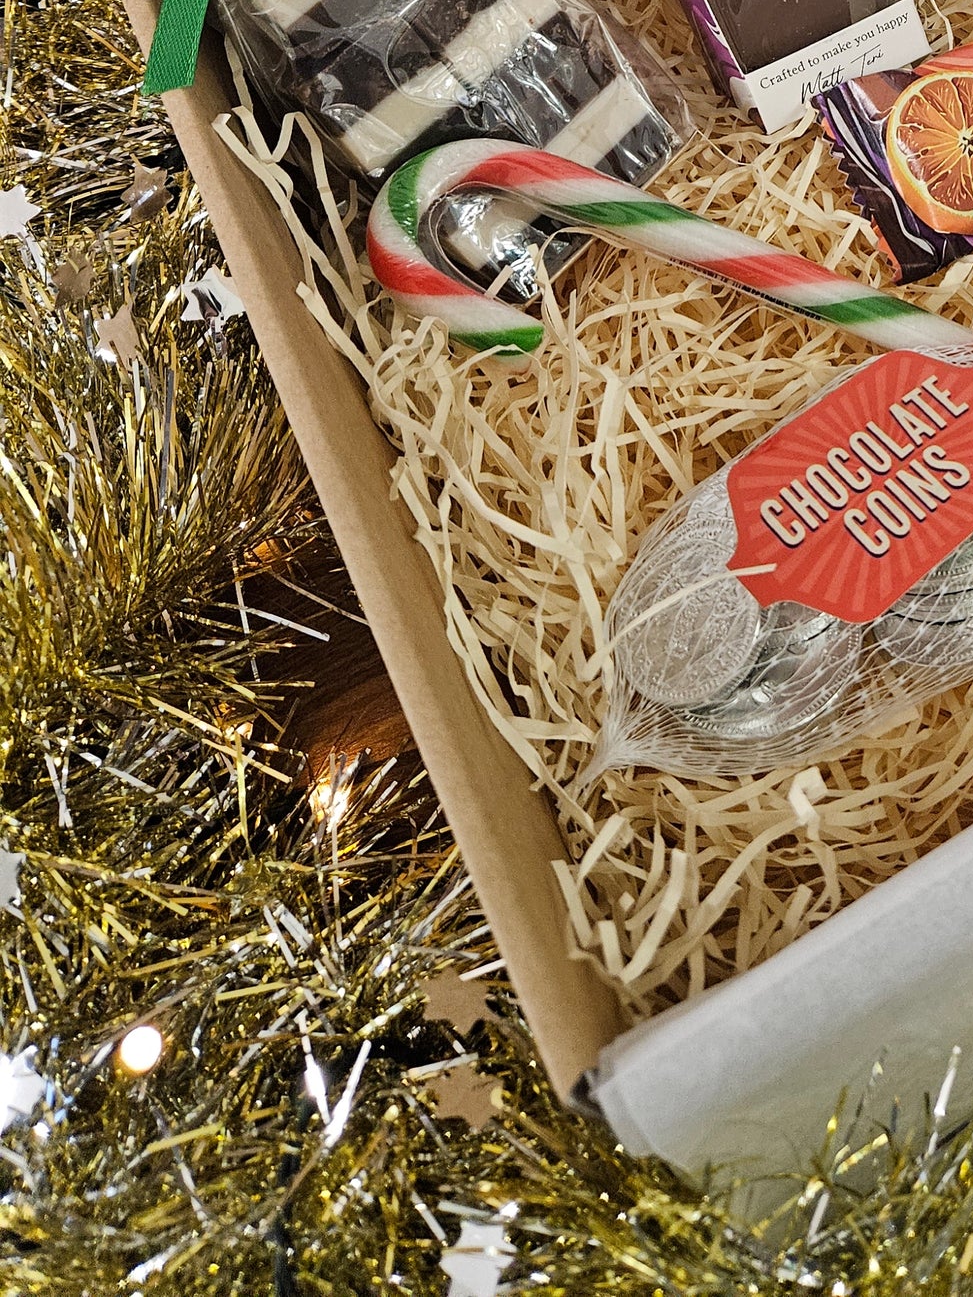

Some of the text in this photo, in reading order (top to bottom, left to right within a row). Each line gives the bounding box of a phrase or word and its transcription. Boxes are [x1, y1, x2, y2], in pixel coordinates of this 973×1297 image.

[759, 11, 909, 90] Crafted to make you happy
[801, 63, 846, 105] Matt
[759, 373, 971, 548] CHOCOLATE
[843, 444, 972, 559] COINS
